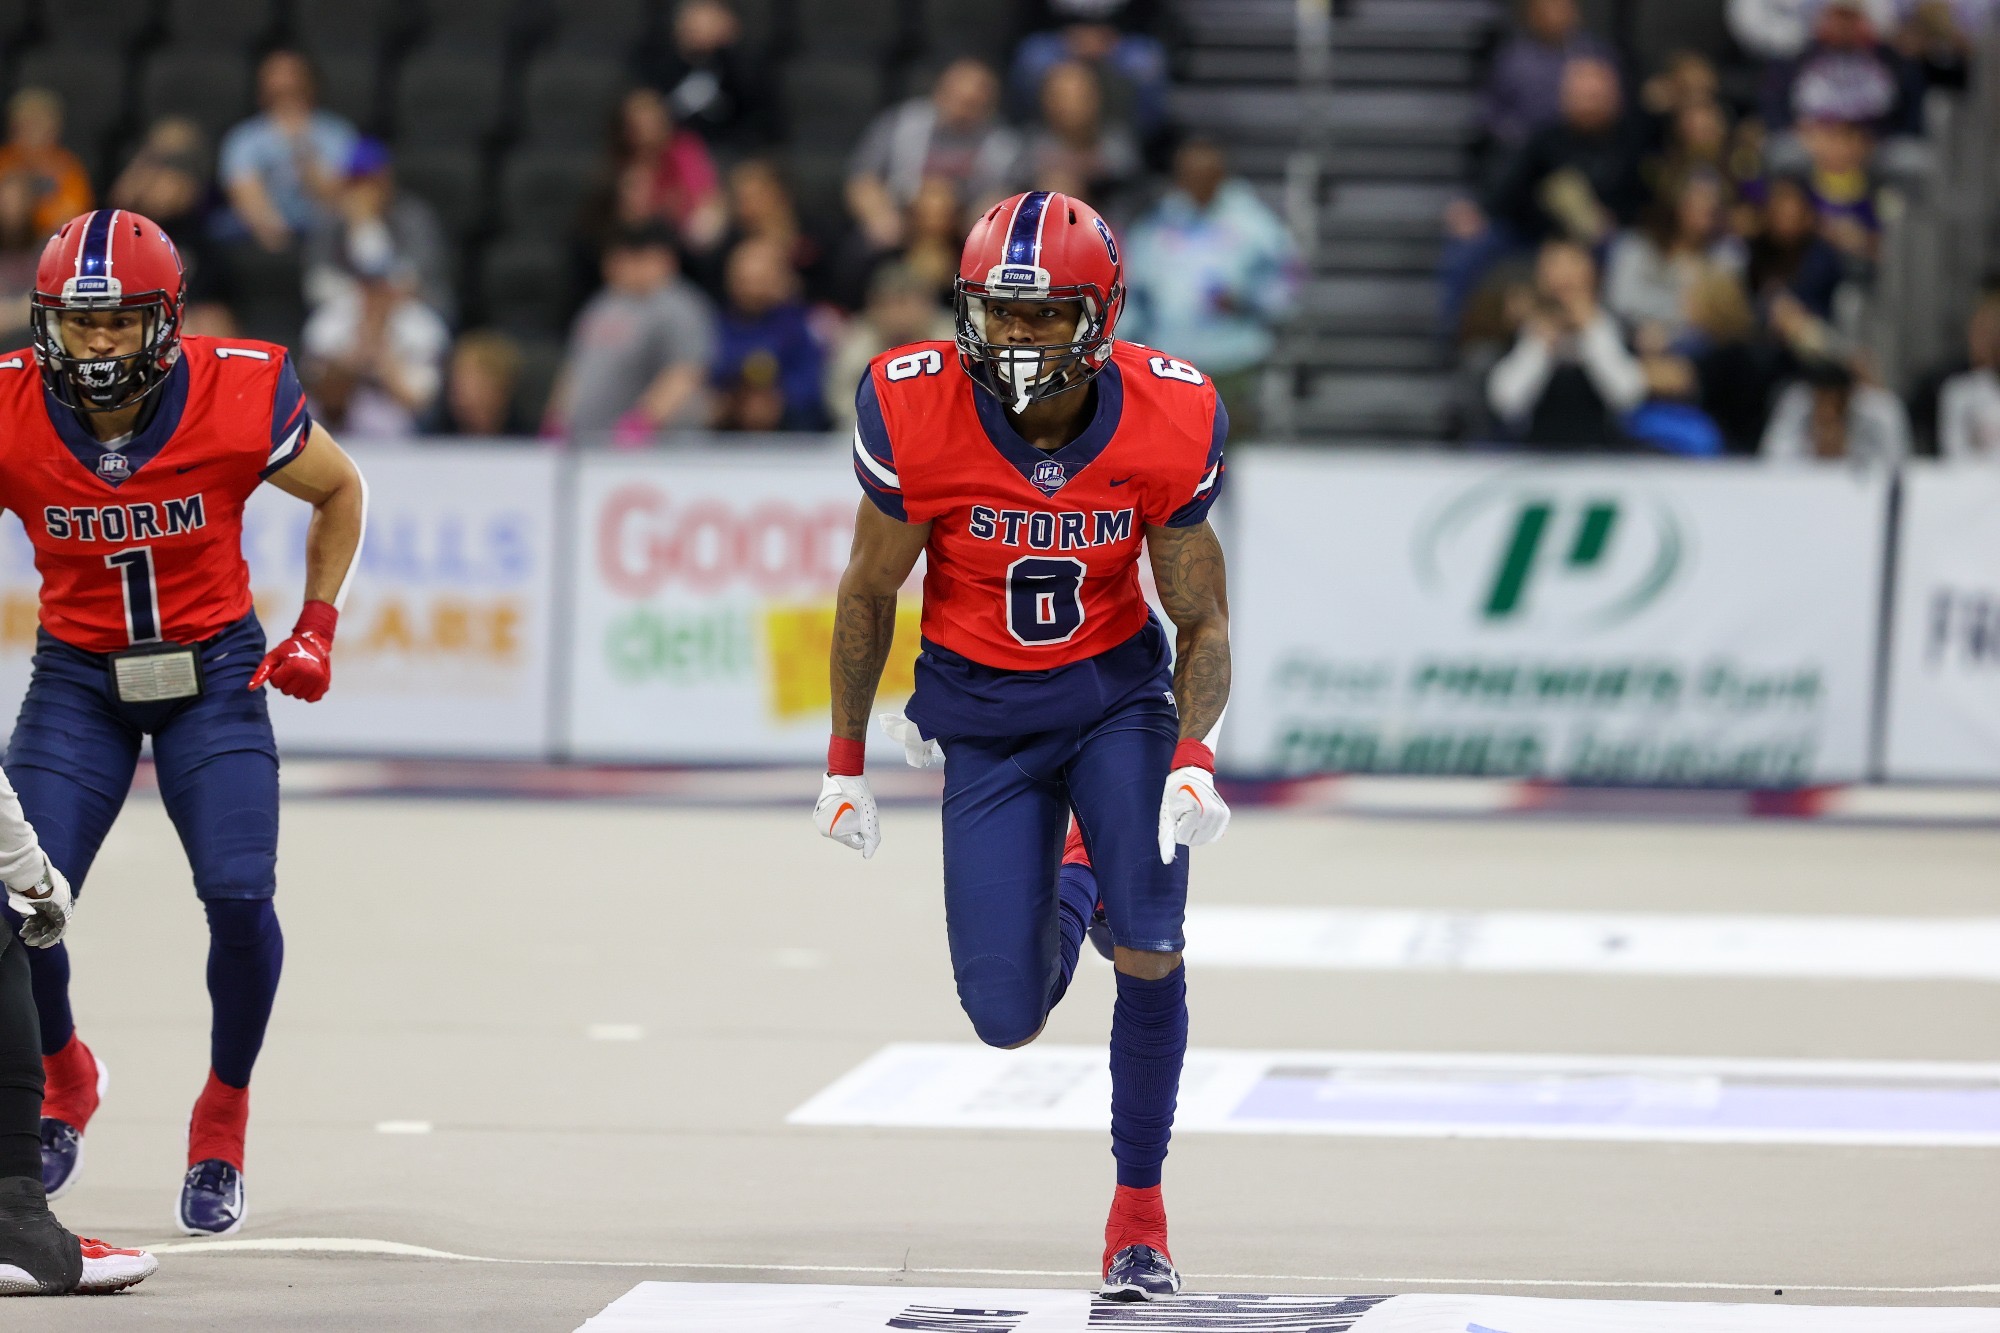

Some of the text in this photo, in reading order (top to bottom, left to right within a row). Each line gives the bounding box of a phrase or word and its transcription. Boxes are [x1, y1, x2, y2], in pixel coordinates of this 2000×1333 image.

[78, 282, 106, 290] STORM
[1004, 272, 1032, 281] STORM
[214, 347, 270, 360] 1
[79, 361, 117, 375] FILTHY
[885, 350, 944, 383] 6
[1147, 356, 1205, 387] 6
[1039, 466, 1060, 479] IFL
[44, 493, 206, 542] STORM
[969, 505, 1134, 550] STORM
[104, 545, 163, 646] 1
